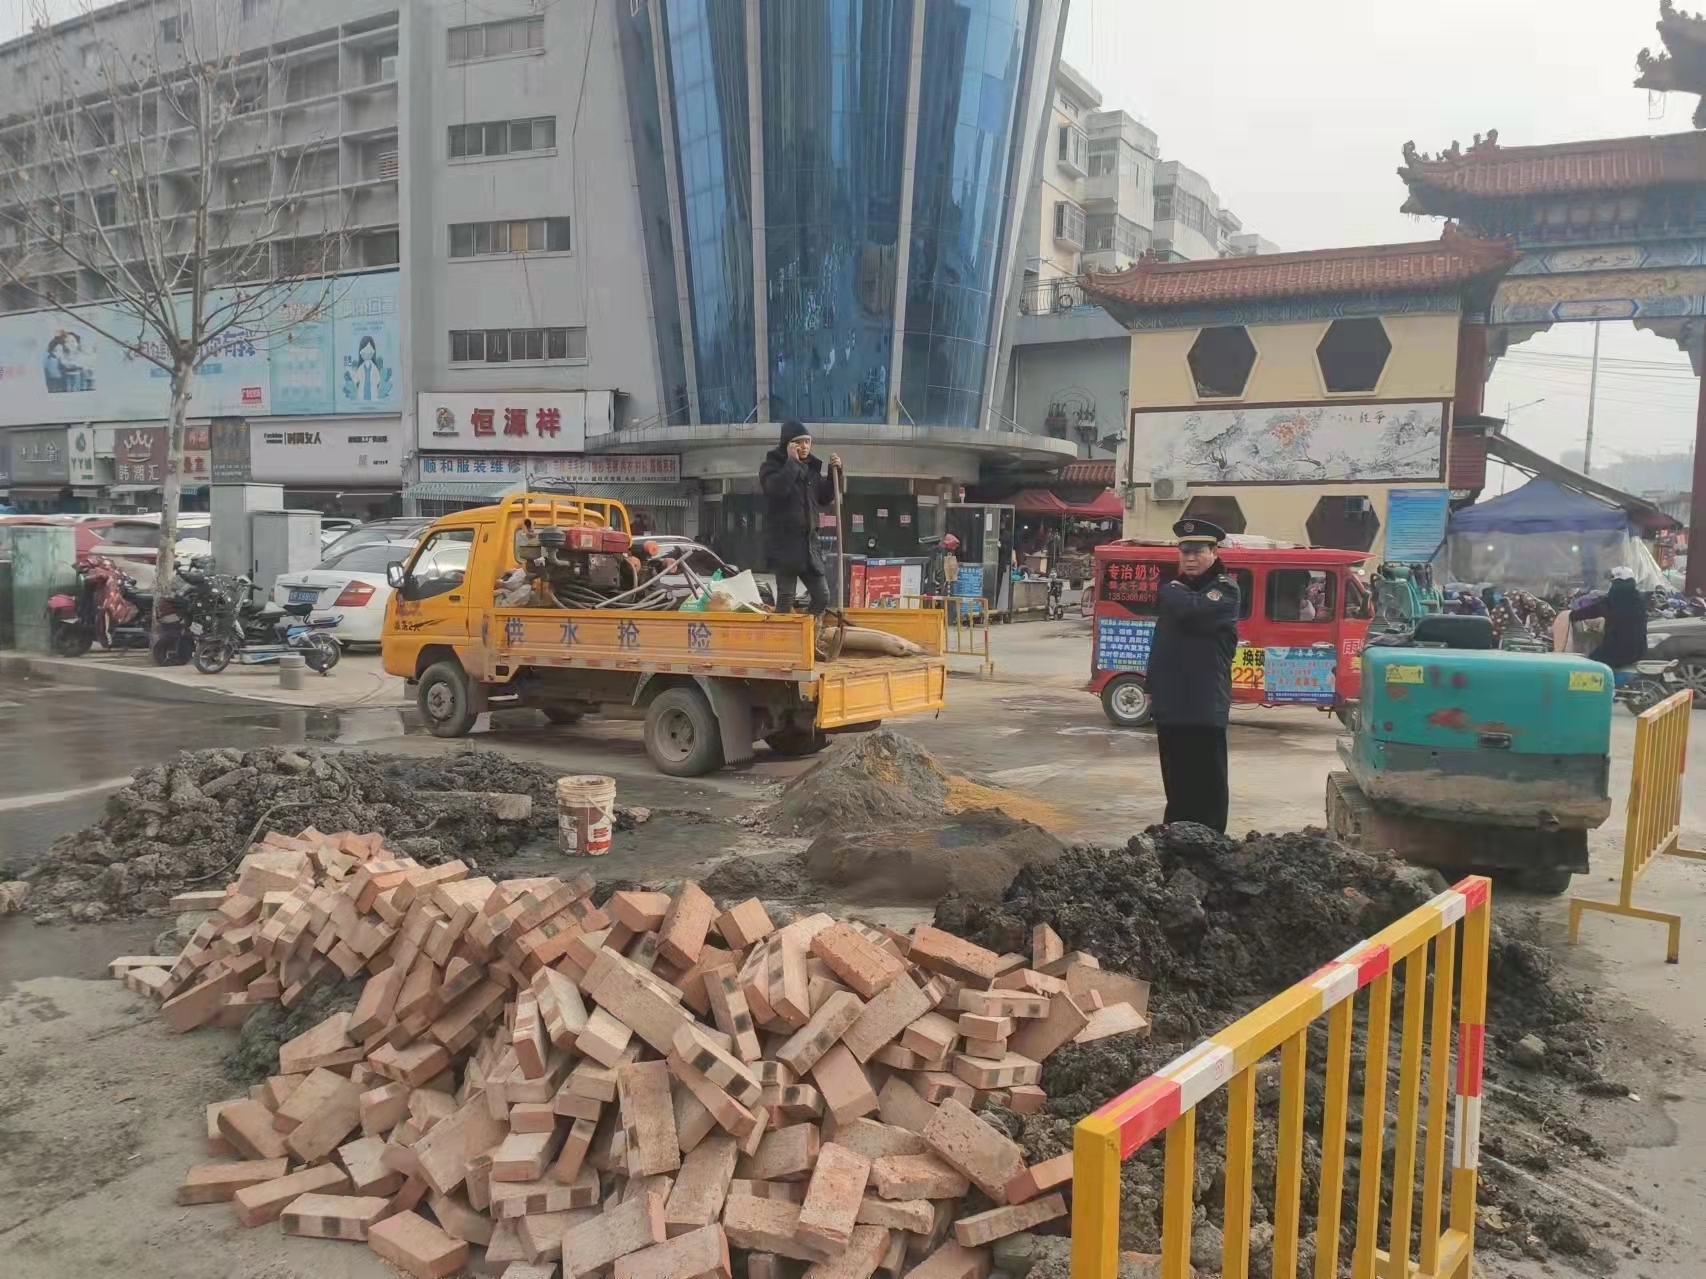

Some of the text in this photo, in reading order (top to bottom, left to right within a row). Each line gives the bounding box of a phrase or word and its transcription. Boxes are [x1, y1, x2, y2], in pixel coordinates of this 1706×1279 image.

[470, 406, 563, 438] 恒源祥
[287, 432, 322, 445] 时尚女人
[423, 457, 521, 473] 顺和服装维修
[1108, 564, 1161, 580] 专治奶少
[504, 617, 713, 653] 供水抢险
[1343, 639, 1365, 654] 雨
